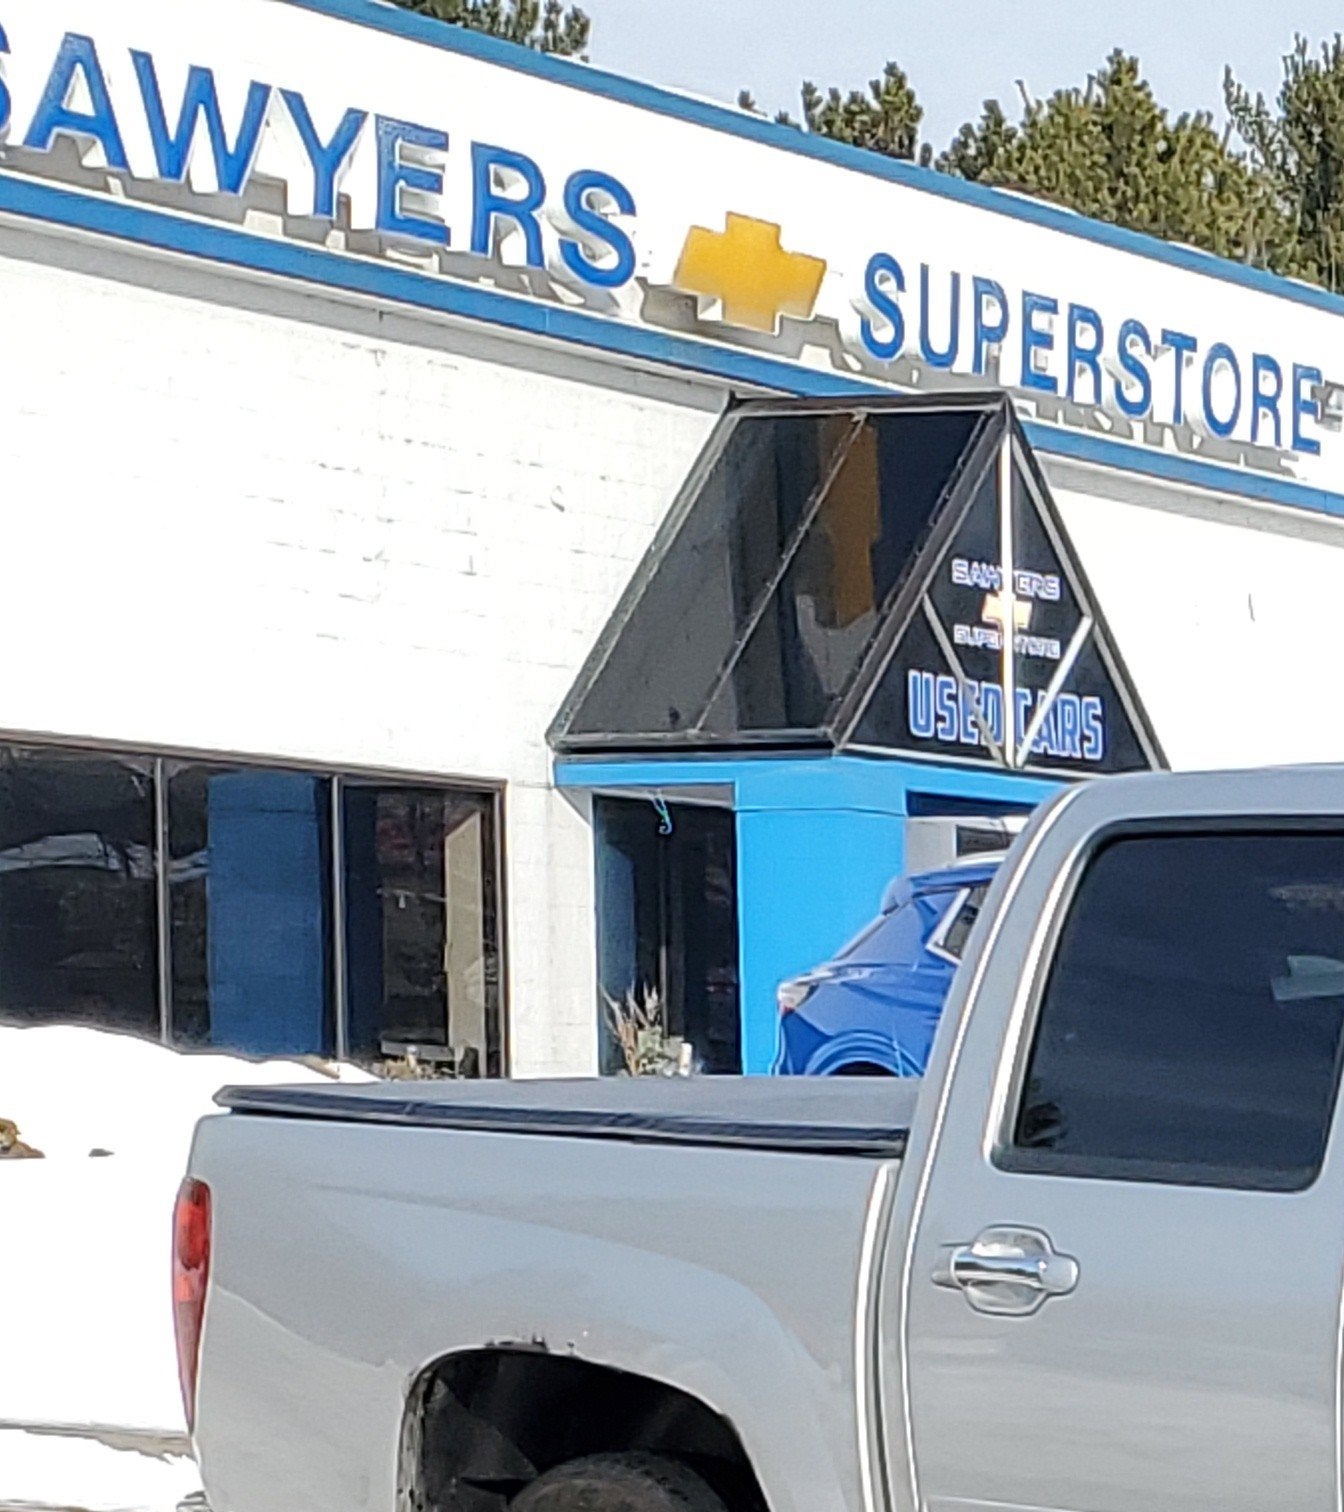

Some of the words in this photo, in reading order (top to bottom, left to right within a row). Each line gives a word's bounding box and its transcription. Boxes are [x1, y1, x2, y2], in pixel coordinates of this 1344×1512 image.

[0, 22, 638, 288] AWYERS
[860, 253, 1323, 455] SUPERSTORE
[951, 558, 1061, 601] SAWERS
[907, 668, 1006, 749] USED
